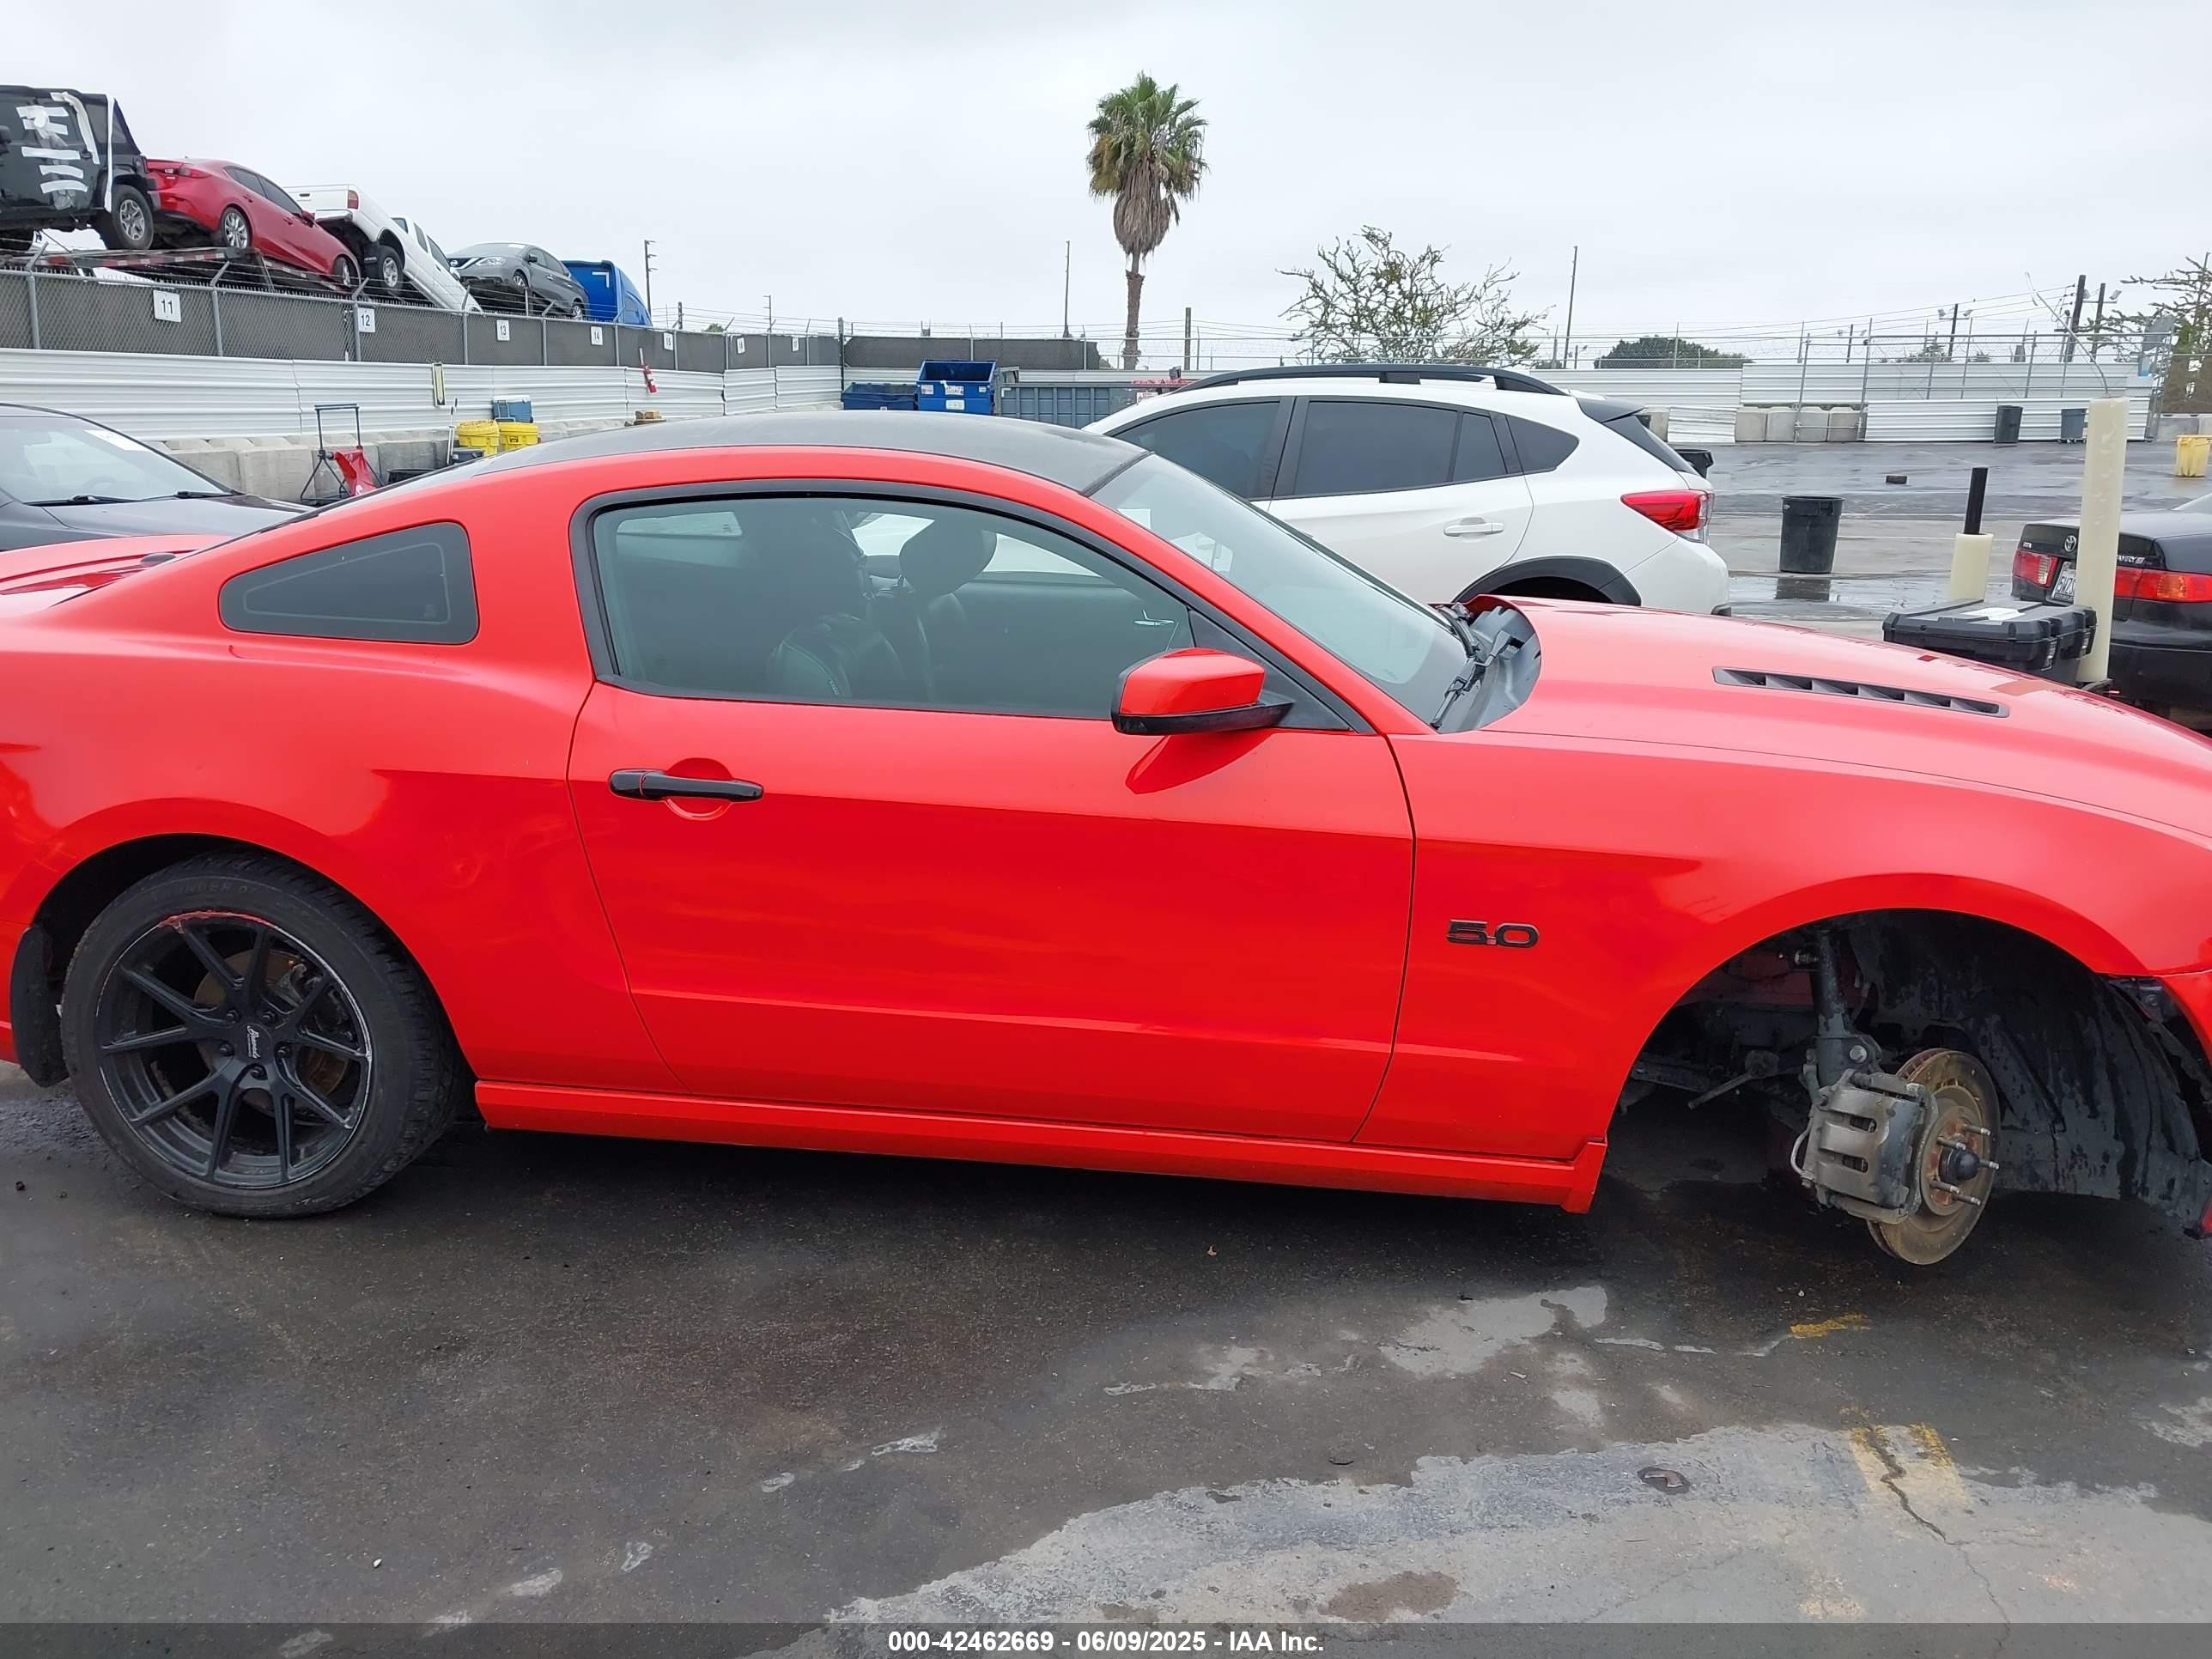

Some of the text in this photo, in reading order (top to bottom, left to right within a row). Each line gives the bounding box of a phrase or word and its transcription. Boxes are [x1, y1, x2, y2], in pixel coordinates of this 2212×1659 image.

[161, 300, 173, 314] 11
[361, 314, 370, 326] 12
[500, 325, 507, 336] 13
[1446, 919, 1539, 949] 5.0
